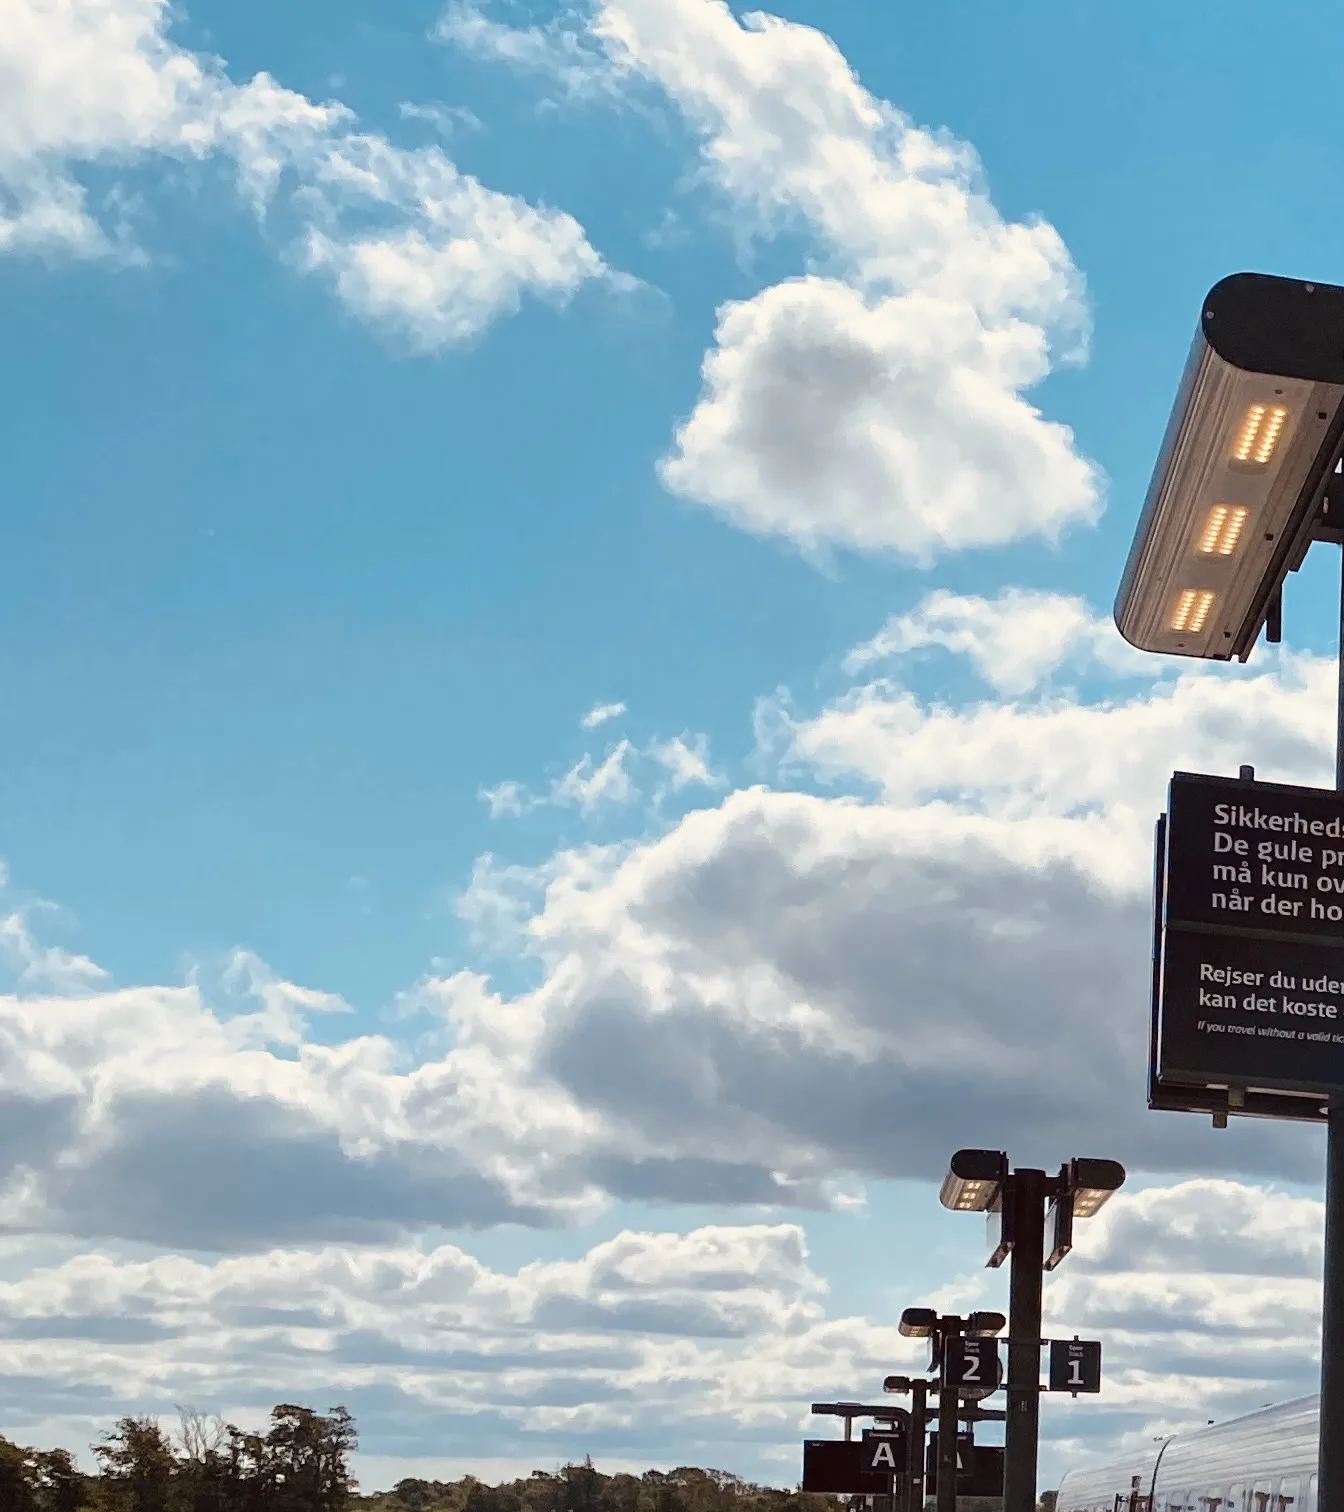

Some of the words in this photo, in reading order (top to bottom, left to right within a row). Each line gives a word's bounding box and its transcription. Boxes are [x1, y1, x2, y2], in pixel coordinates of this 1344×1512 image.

[1214, 832, 1250, 856] De
[1257, 840, 1313, 863] gule
[1213, 861, 1252, 883] må
[1261, 864, 1308, 890] kun
[1212, 888, 1255, 911] når
[1260, 893, 1304, 917] der
[1200, 964, 1265, 987] Rejser
[1269, 970, 1296, 990] du
[1199, 988, 1237, 1009] kan
[1242, 994, 1277, 1013] det
[1282, 996, 1338, 1019] koste
[1206, 1023, 1226, 1033] you
[1227, 1024, 1256, 1036] travel
[1257, 1027, 1296, 1040] without
[1306, 1031, 1331, 1042] valid
[962, 1355, 981, 1381] 2
[1067, 1360, 1085, 1385] 1
[871, 1442, 896, 1467] A
